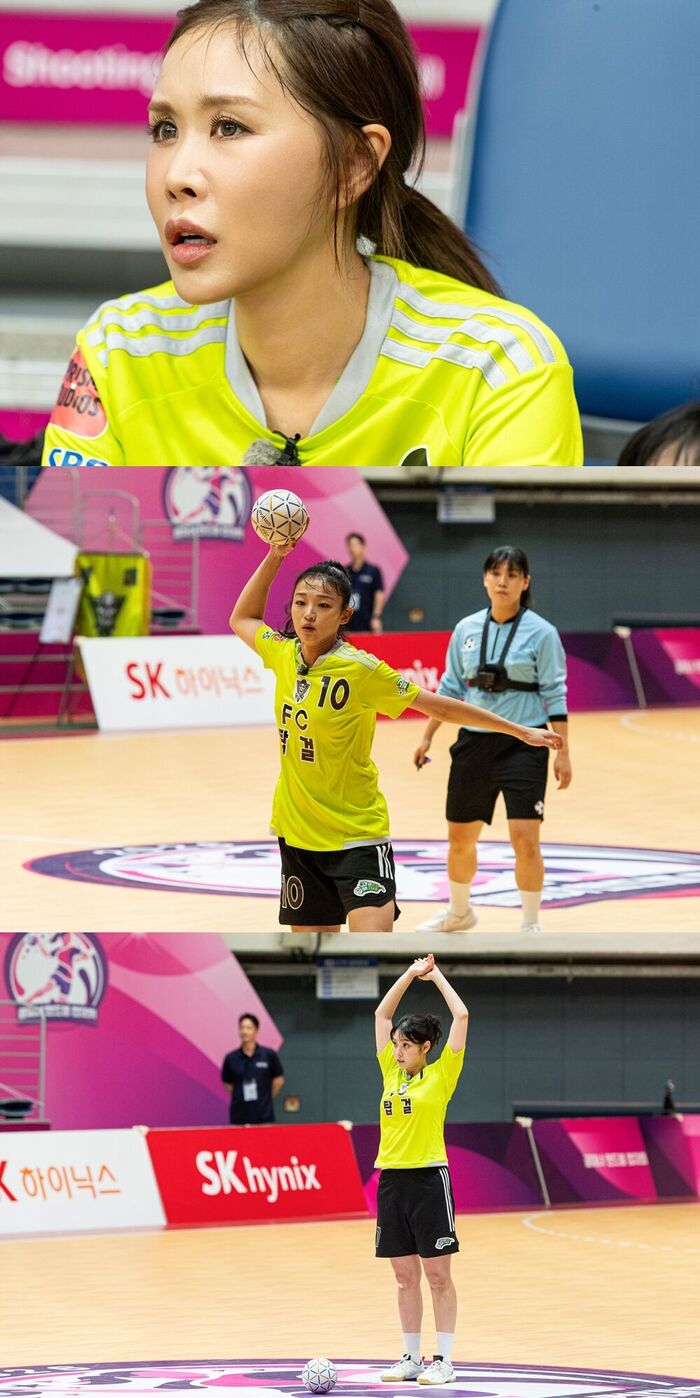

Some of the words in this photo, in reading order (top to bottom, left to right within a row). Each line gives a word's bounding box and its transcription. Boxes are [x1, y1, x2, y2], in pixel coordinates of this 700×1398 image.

[126, 663, 171, 699] SK
[175, 667, 265, 698] 하이닉스
[317, 675, 350, 710] 10
[282, 703, 308, 731] FC
[20, 1164, 121, 1201] 하이닉스
[196, 1150, 248, 1196] SK
[242, 1155, 321, 1203] hynix
